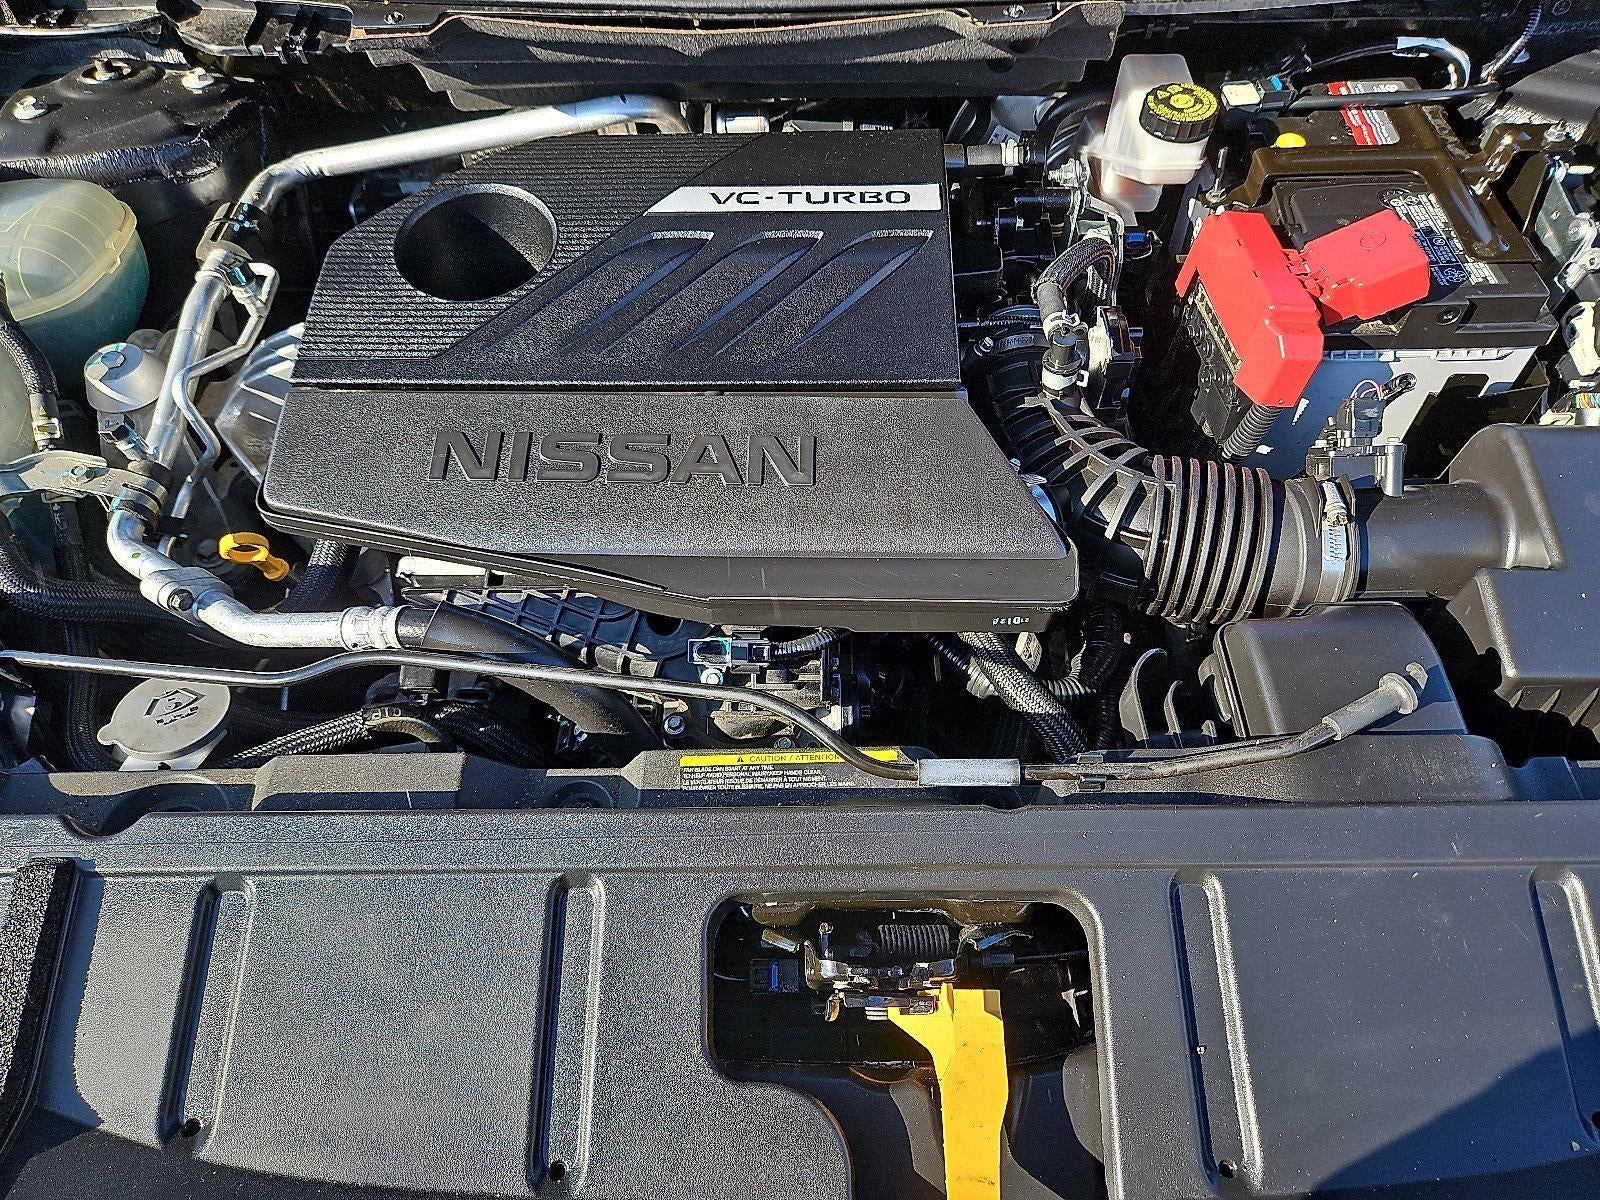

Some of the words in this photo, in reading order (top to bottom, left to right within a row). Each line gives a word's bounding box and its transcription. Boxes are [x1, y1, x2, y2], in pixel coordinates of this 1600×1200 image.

[708, 190, 911, 205] VC-TURBO
[428, 430, 817, 487] NISSAN
[749, 755, 787, 763] CAUTION
